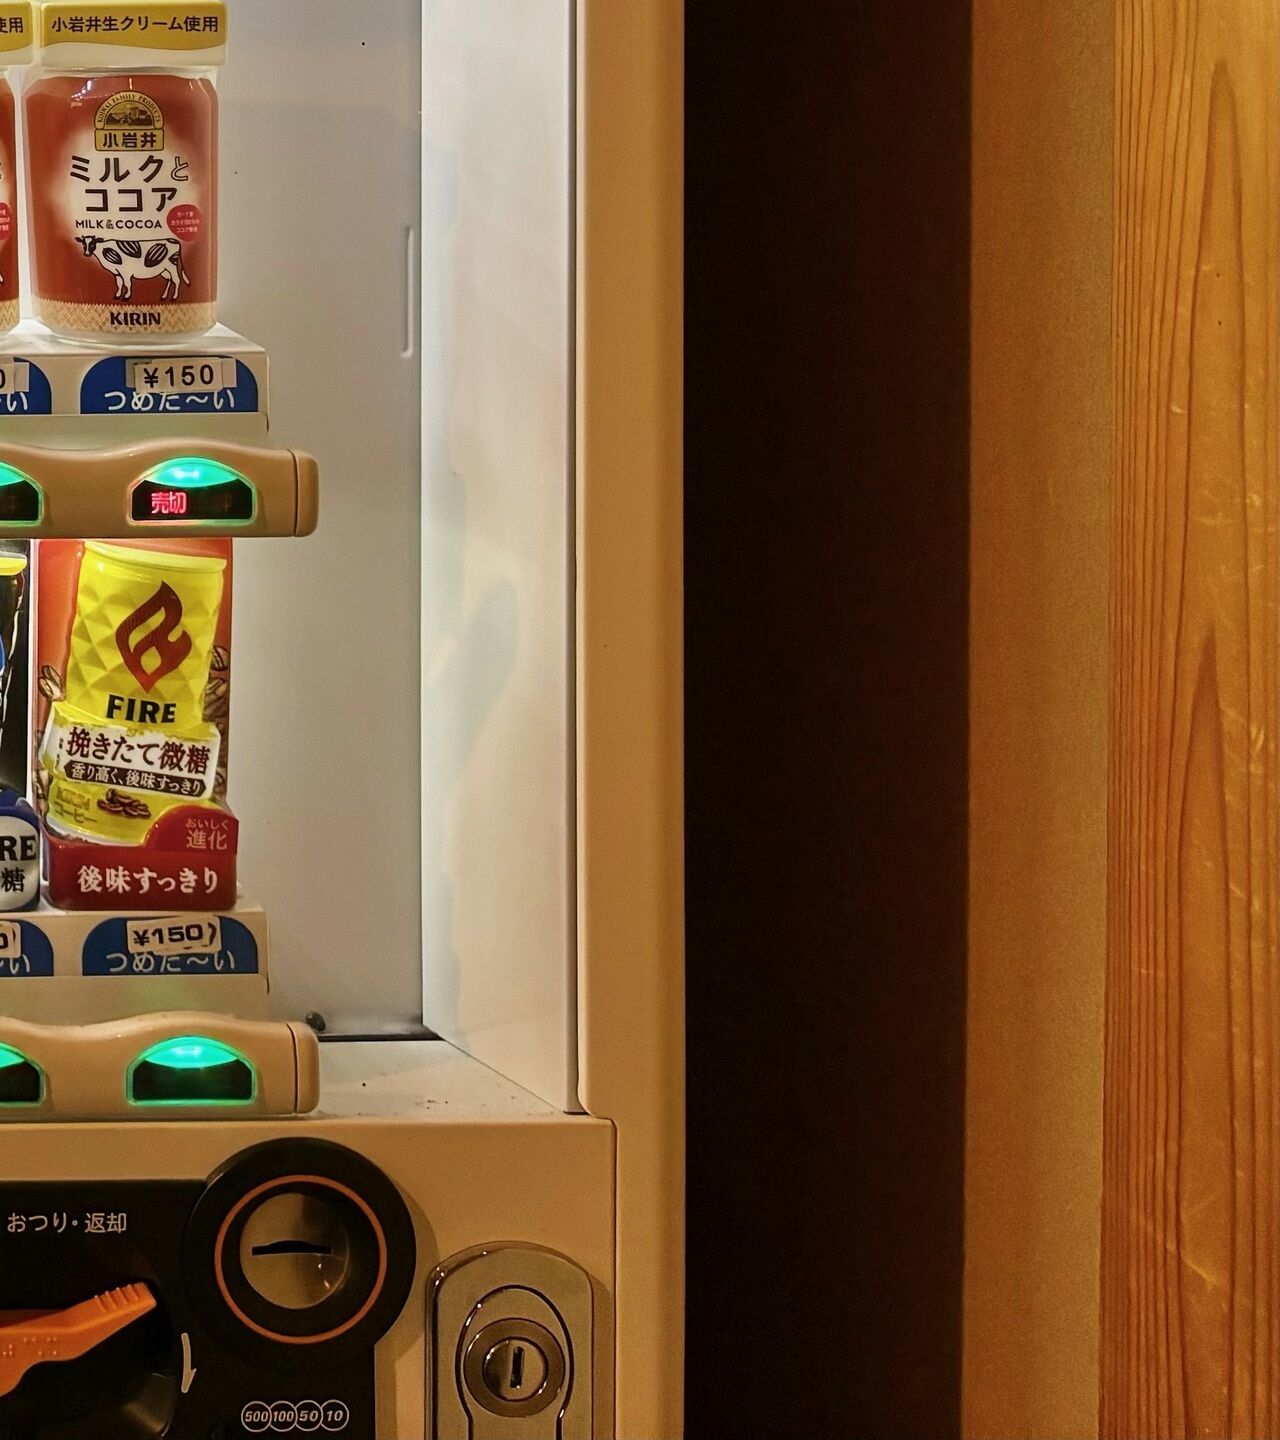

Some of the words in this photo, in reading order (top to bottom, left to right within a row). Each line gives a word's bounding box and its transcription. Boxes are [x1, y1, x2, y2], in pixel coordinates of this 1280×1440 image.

[51, 16, 218, 32] 小岩井生クリーム使用
[103, 133, 157, 148] 小岩井
[110, 311, 161, 326] KIRIN
[145, 364, 214, 386] ¥150
[151, 492, 187, 514] 売切
[106, 694, 177, 723] FIRE
[67, 726, 211, 775] 挽きたて微糖
[185, 818, 228, 829] おいしく
[185, 830, 227, 850] 進化
[78, 866, 218, 894] 後味すっきり
[133, 927, 203, 945] ¥150
[7, 1212, 127, 1234] おつり・返却
[244, 1410, 269, 1422] 500
[272, 1410, 294, 1422] 100
[298, 1410, 320, 1422] 50
[325, 1410, 343, 1422] 10
